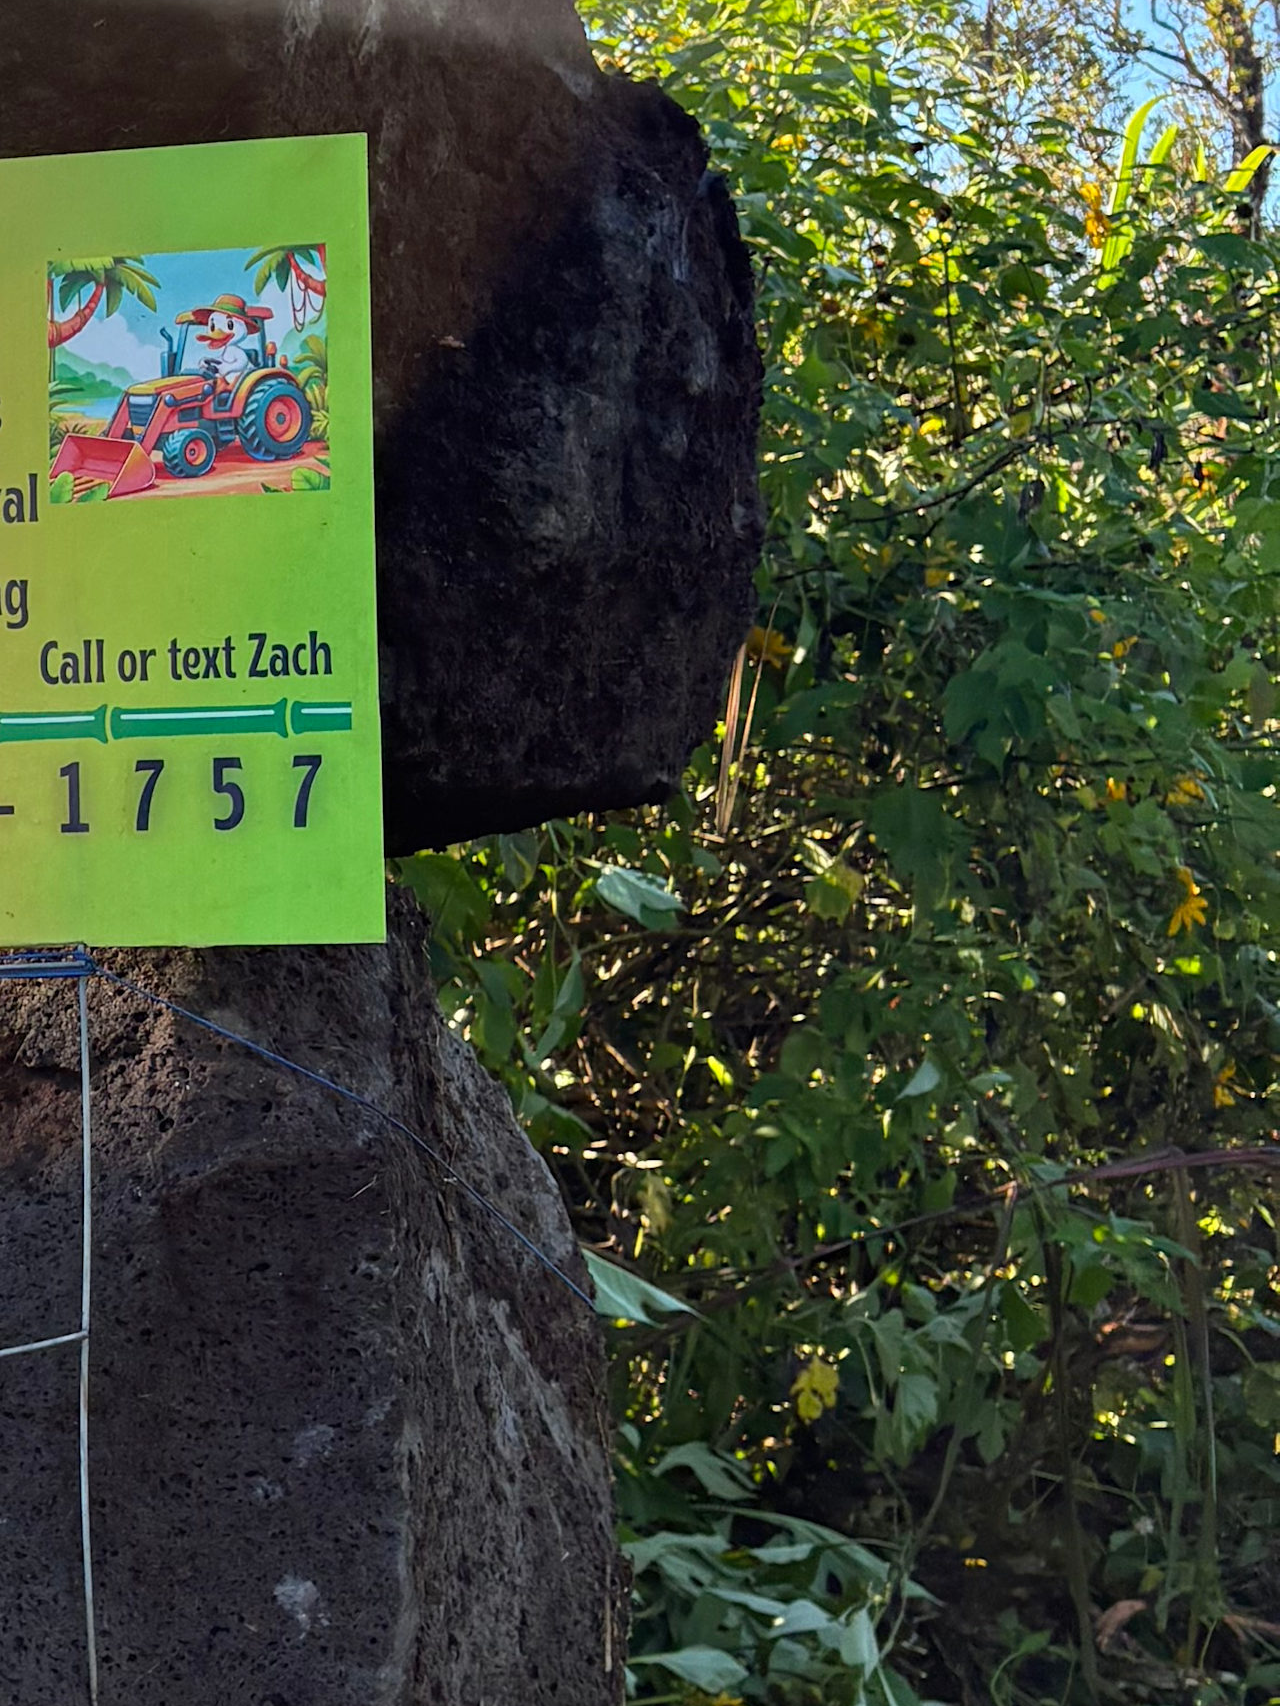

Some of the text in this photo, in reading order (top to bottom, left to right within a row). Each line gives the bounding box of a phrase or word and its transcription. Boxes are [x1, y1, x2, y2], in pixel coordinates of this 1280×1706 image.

[40, 630, 333, 685] Call or text Zach
